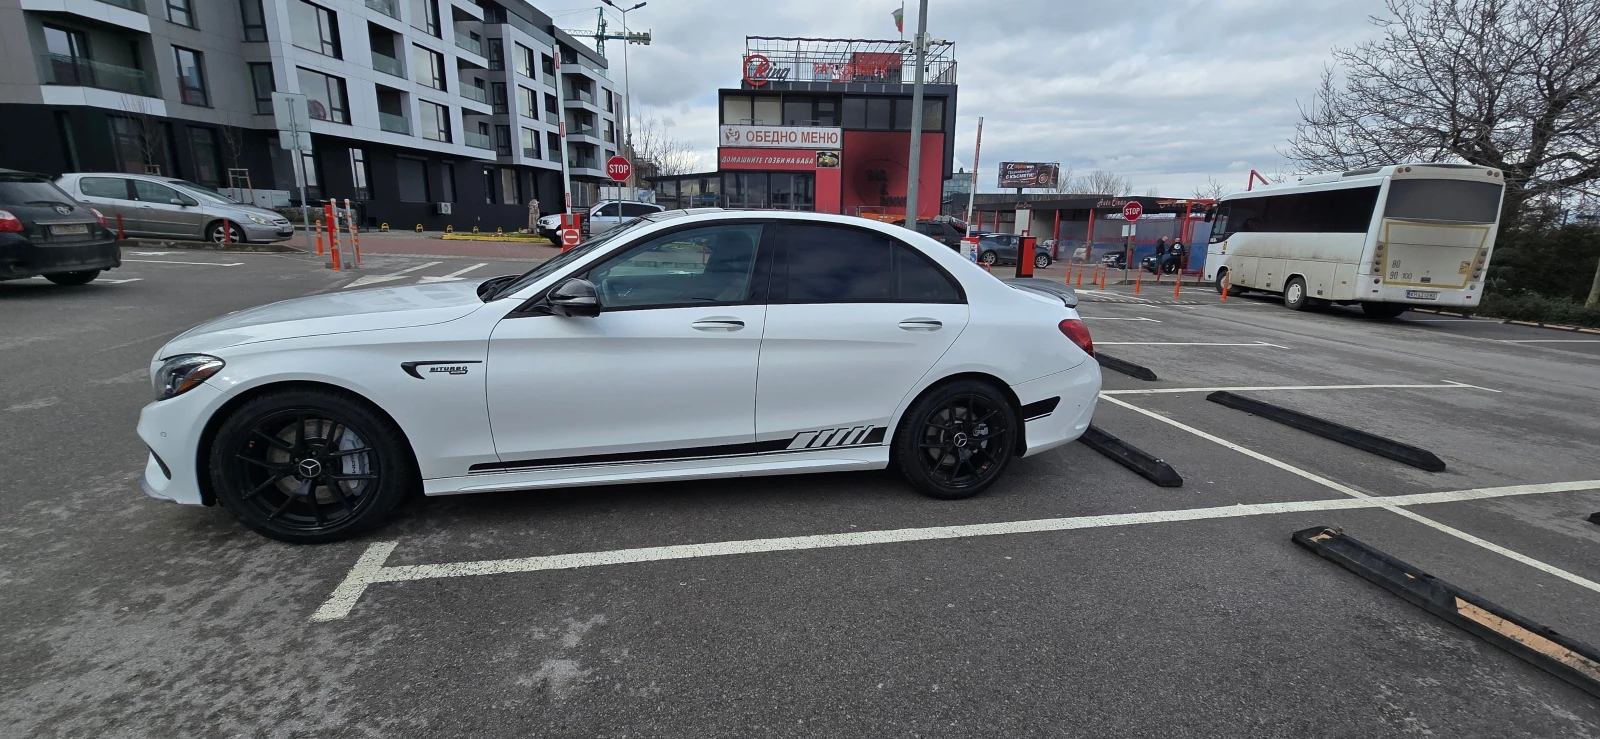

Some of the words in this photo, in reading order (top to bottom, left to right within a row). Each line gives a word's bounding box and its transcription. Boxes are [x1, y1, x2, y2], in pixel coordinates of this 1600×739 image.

[746, 130, 798, 144] ОБЕДНО
[801, 131, 839, 144] МЕНЮ
[721, 156, 763, 164] ДОМАШНИТЕ
[764, 156, 786, 164] ГОЗБИ
[796, 157, 814, 165] БАБА
[609, 164, 629, 174] STOP
[1097, 198, 1111, 208] Auto
[1125, 207, 1140, 216] STOP
[1391, 260, 1401, 268] 80
[1389, 271, 1398, 280] 90
